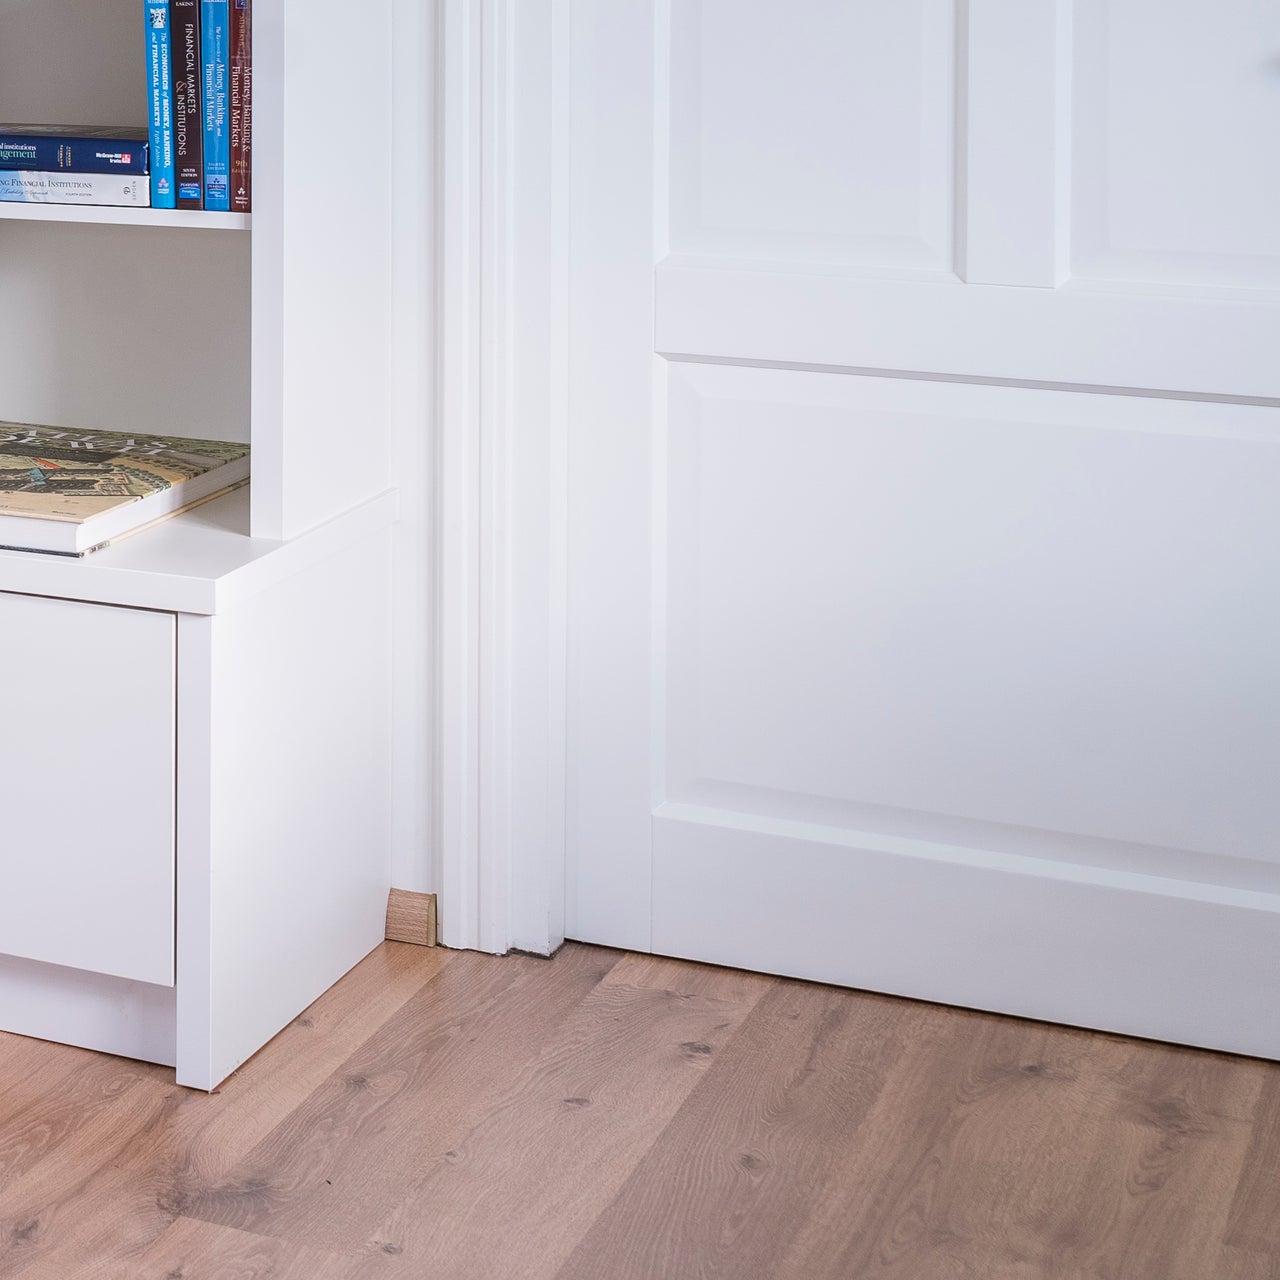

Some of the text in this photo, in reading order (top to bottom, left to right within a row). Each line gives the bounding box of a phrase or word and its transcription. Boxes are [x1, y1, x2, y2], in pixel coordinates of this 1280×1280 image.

[185, 23, 196, 113] FINANCIAL MARKETS
[177, 95, 186, 155] INSTITUTIONS
